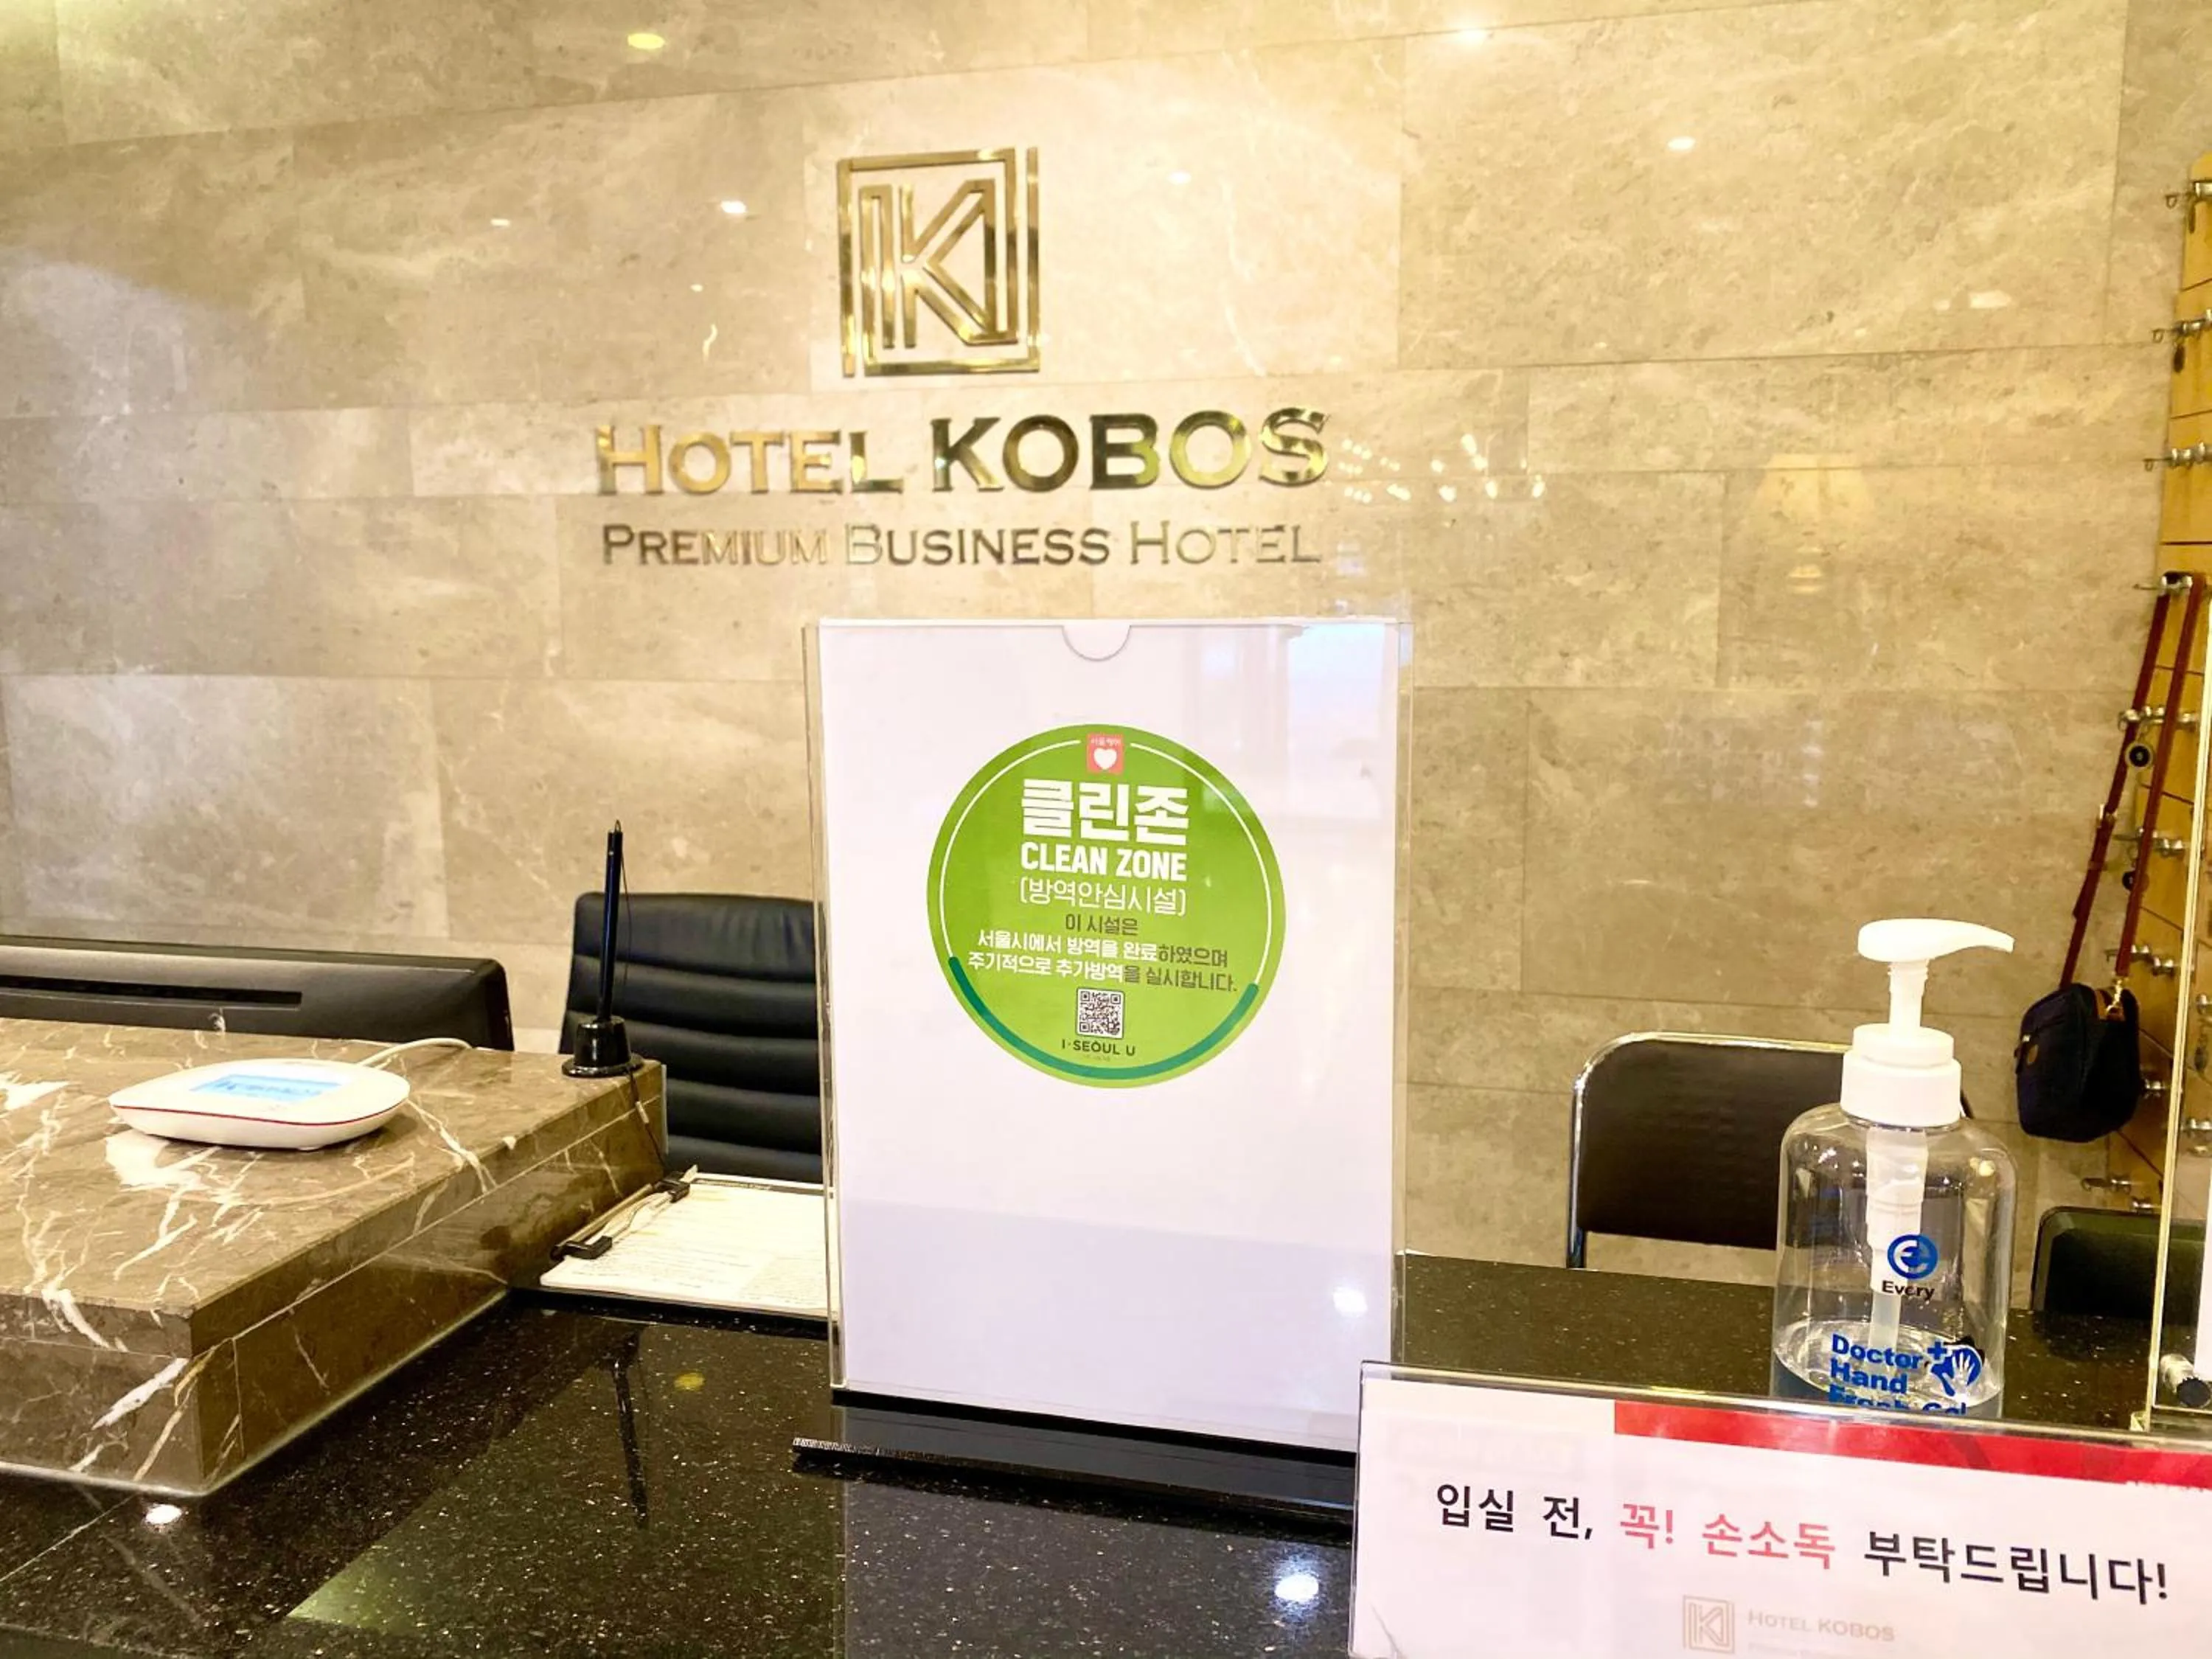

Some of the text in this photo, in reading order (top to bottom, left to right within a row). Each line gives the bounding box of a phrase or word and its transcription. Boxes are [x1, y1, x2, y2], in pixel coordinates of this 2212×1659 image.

[931, 406, 1330, 493] KOBOS
[1021, 778, 1189, 846] 클린존
[1021, 842, 1187, 882] CLEAN ZONE
[1065, 914, 1139, 937] 이 시설은
[977, 928, 1229, 969] 서울시에서 방역을 완료하였으며
[967, 950, 1239, 993] 주기적으로 추가방역을 실시합니다.
[1881, 1279, 1936, 1300] Every
[1832, 1333, 1923, 1369] Doctor
[1829, 1358, 1908, 1395] Hand
[1436, 1483, 2170, 1606] 입실 전, 꼭! 손소독 부탁드립니다!
[1818, 1617, 1896, 1642] KOBOS
